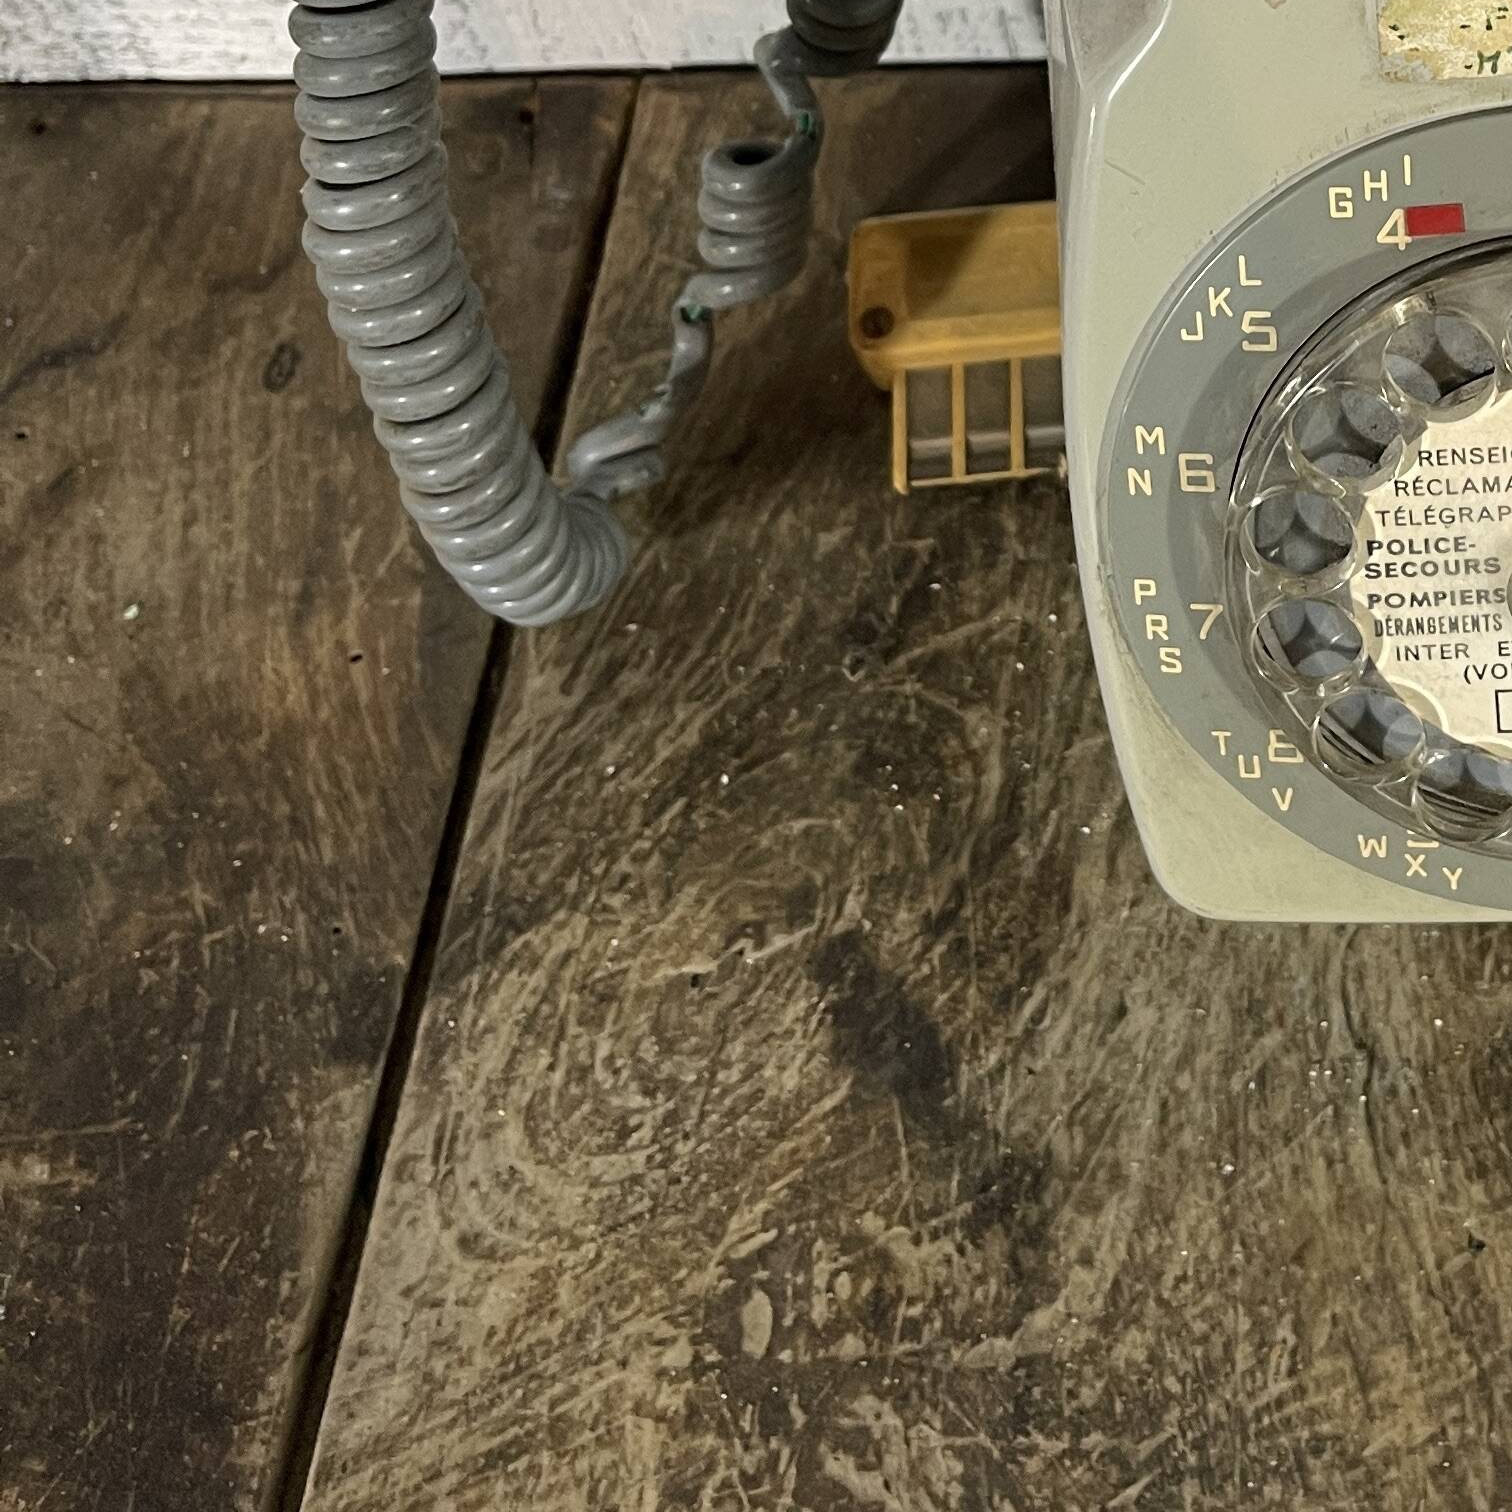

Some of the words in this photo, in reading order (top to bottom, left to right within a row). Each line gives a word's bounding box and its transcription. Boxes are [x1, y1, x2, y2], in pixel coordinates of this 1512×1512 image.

[1376, 208, 1412, 251] 4
[1241, 310, 1278, 352] 5
[1177, 452, 1216, 494] 6
[1366, 536, 1477, 557] POLICE-
[1364, 557, 1502, 580] SECOURS
[1367, 587, 1507, 610] POMPIERS
[1189, 603, 1224, 640] 7
[1374, 613, 1504, 638] DÉRANGEMENTS
[1396, 640, 1470, 662] INTER
